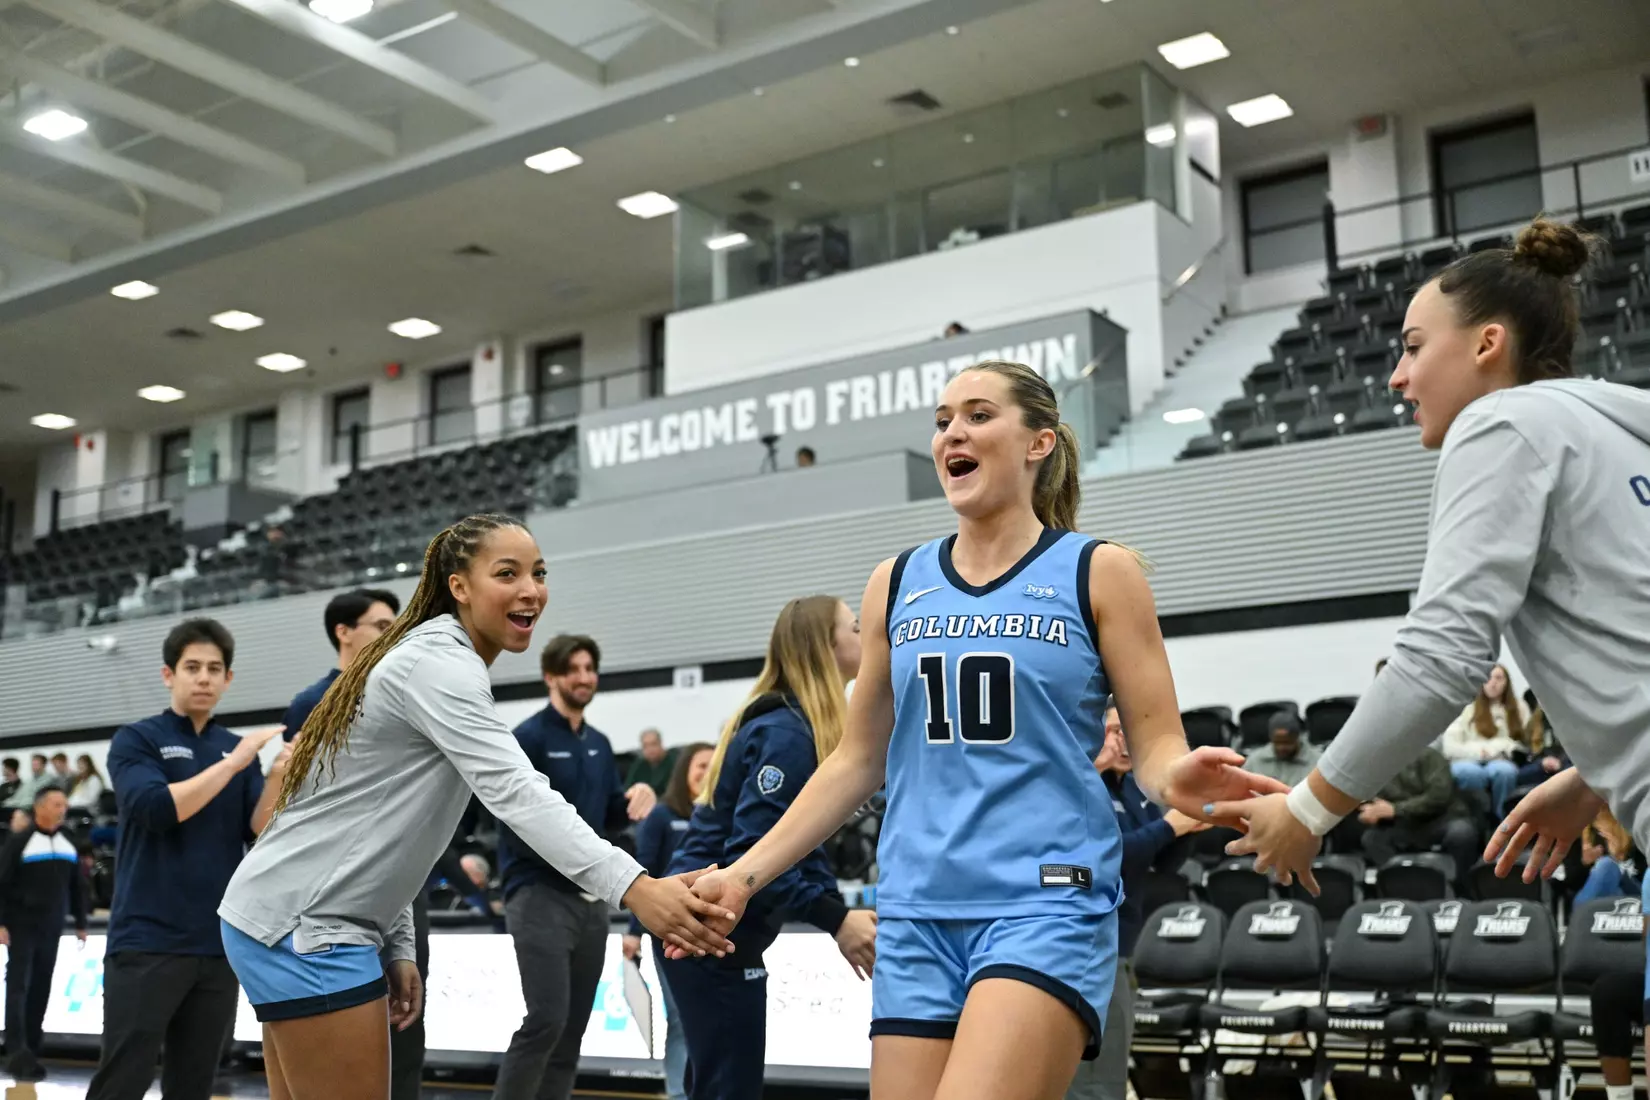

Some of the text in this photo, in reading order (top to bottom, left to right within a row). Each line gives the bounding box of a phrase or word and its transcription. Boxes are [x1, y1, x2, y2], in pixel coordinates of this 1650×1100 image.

[587, 333, 1077, 470] WELCOME TO FRIARWN
[895, 614, 1069, 648] COLUMBIA
[917, 651, 1016, 745] 10
[1077, 871, 1086, 882] L
[1220, 1015, 1275, 1027] FRIARTOWN
[1327, 1018, 1385, 1031] FRIARTOWN
[1448, 1022, 1508, 1034] FRIARTOWN
